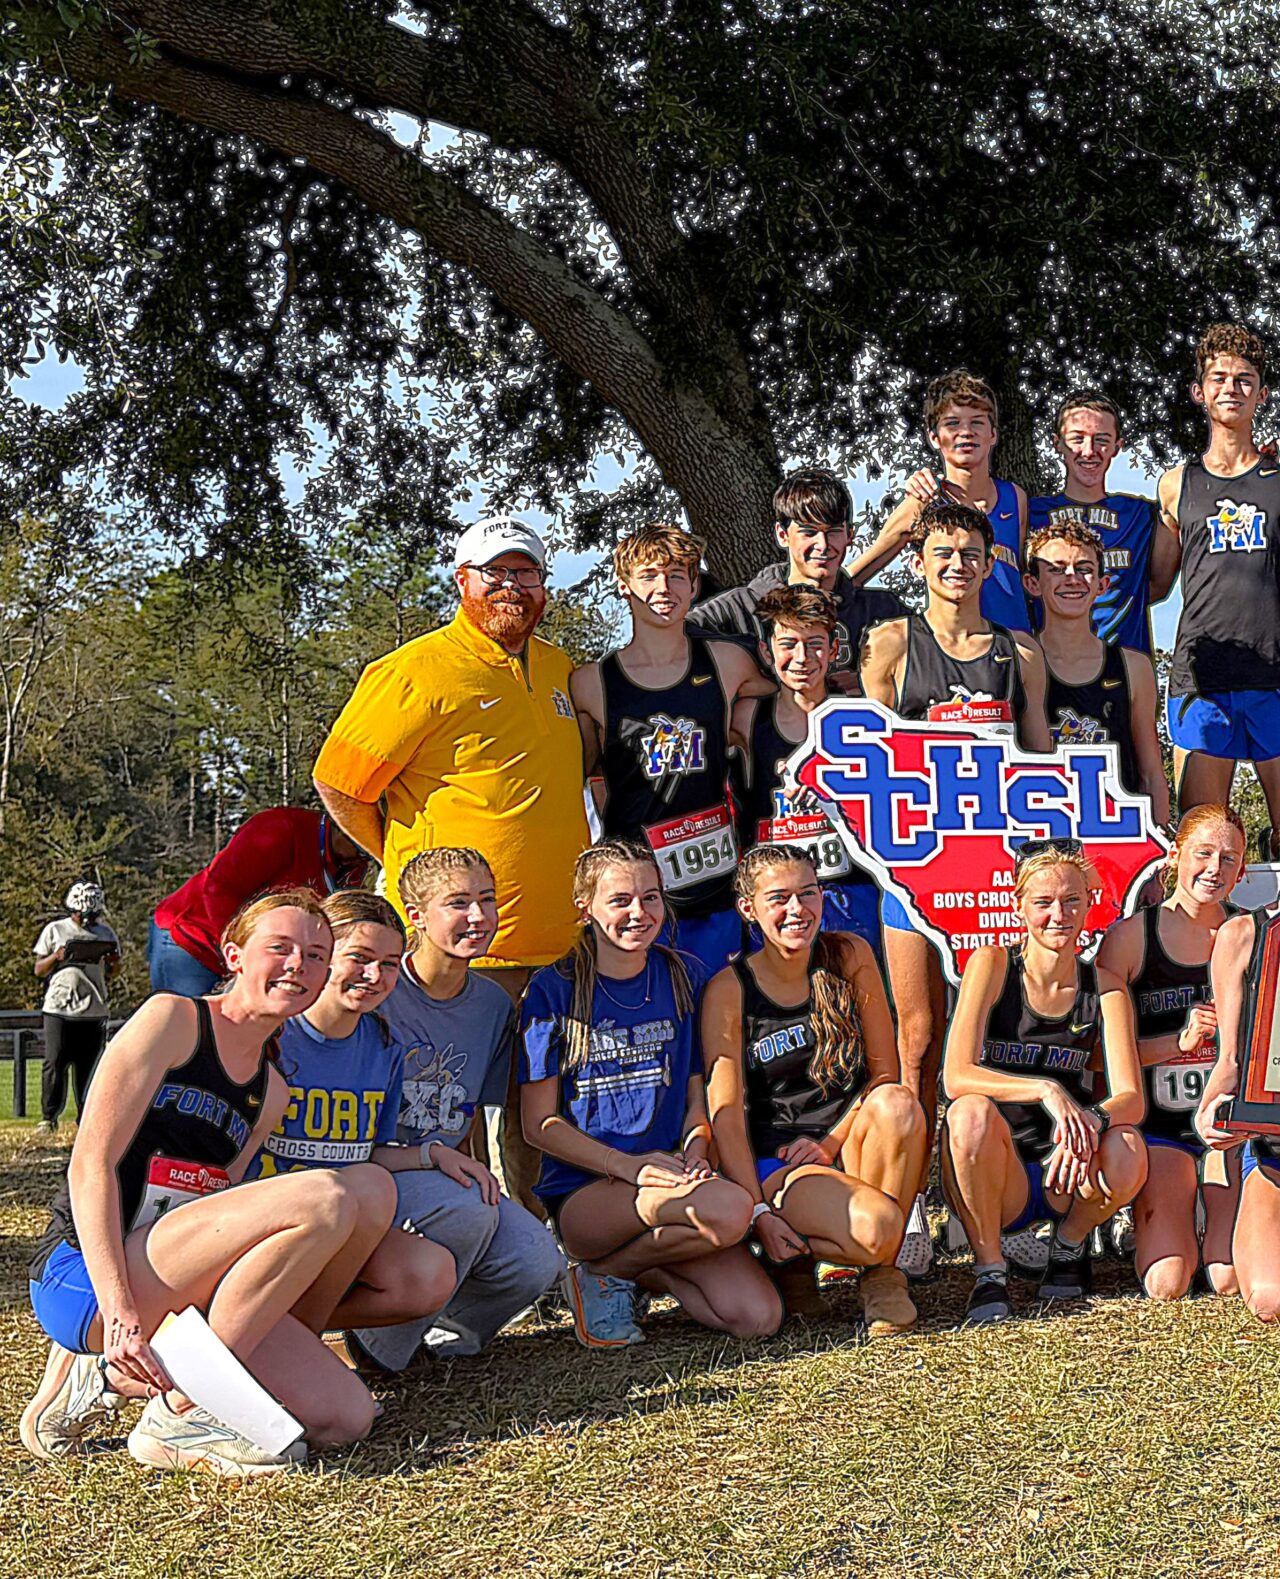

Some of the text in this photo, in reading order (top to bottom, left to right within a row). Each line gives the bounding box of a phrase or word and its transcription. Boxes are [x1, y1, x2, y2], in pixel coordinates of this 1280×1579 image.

[483, 522, 508, 537] FORT
[1050, 507, 1118, 529] FORT MILL
[941, 708, 1002, 721] RACE RESULT
[663, 813, 722, 840] RACE RESULT
[664, 832, 736, 881] 1954
[933, 892, 975, 909] BOYS
[951, 933, 996, 950] STATE
[1140, 986, 1194, 1015] FORT
[747, 1024, 807, 1069] FORT
[1163, 1069, 1212, 1101] 19
[154, 1083, 226, 1128] FORT
[274, 1086, 385, 1140] FORT
[266, 1137, 316, 1158] CROSS
[169, 1168, 198, 1184] RACE
